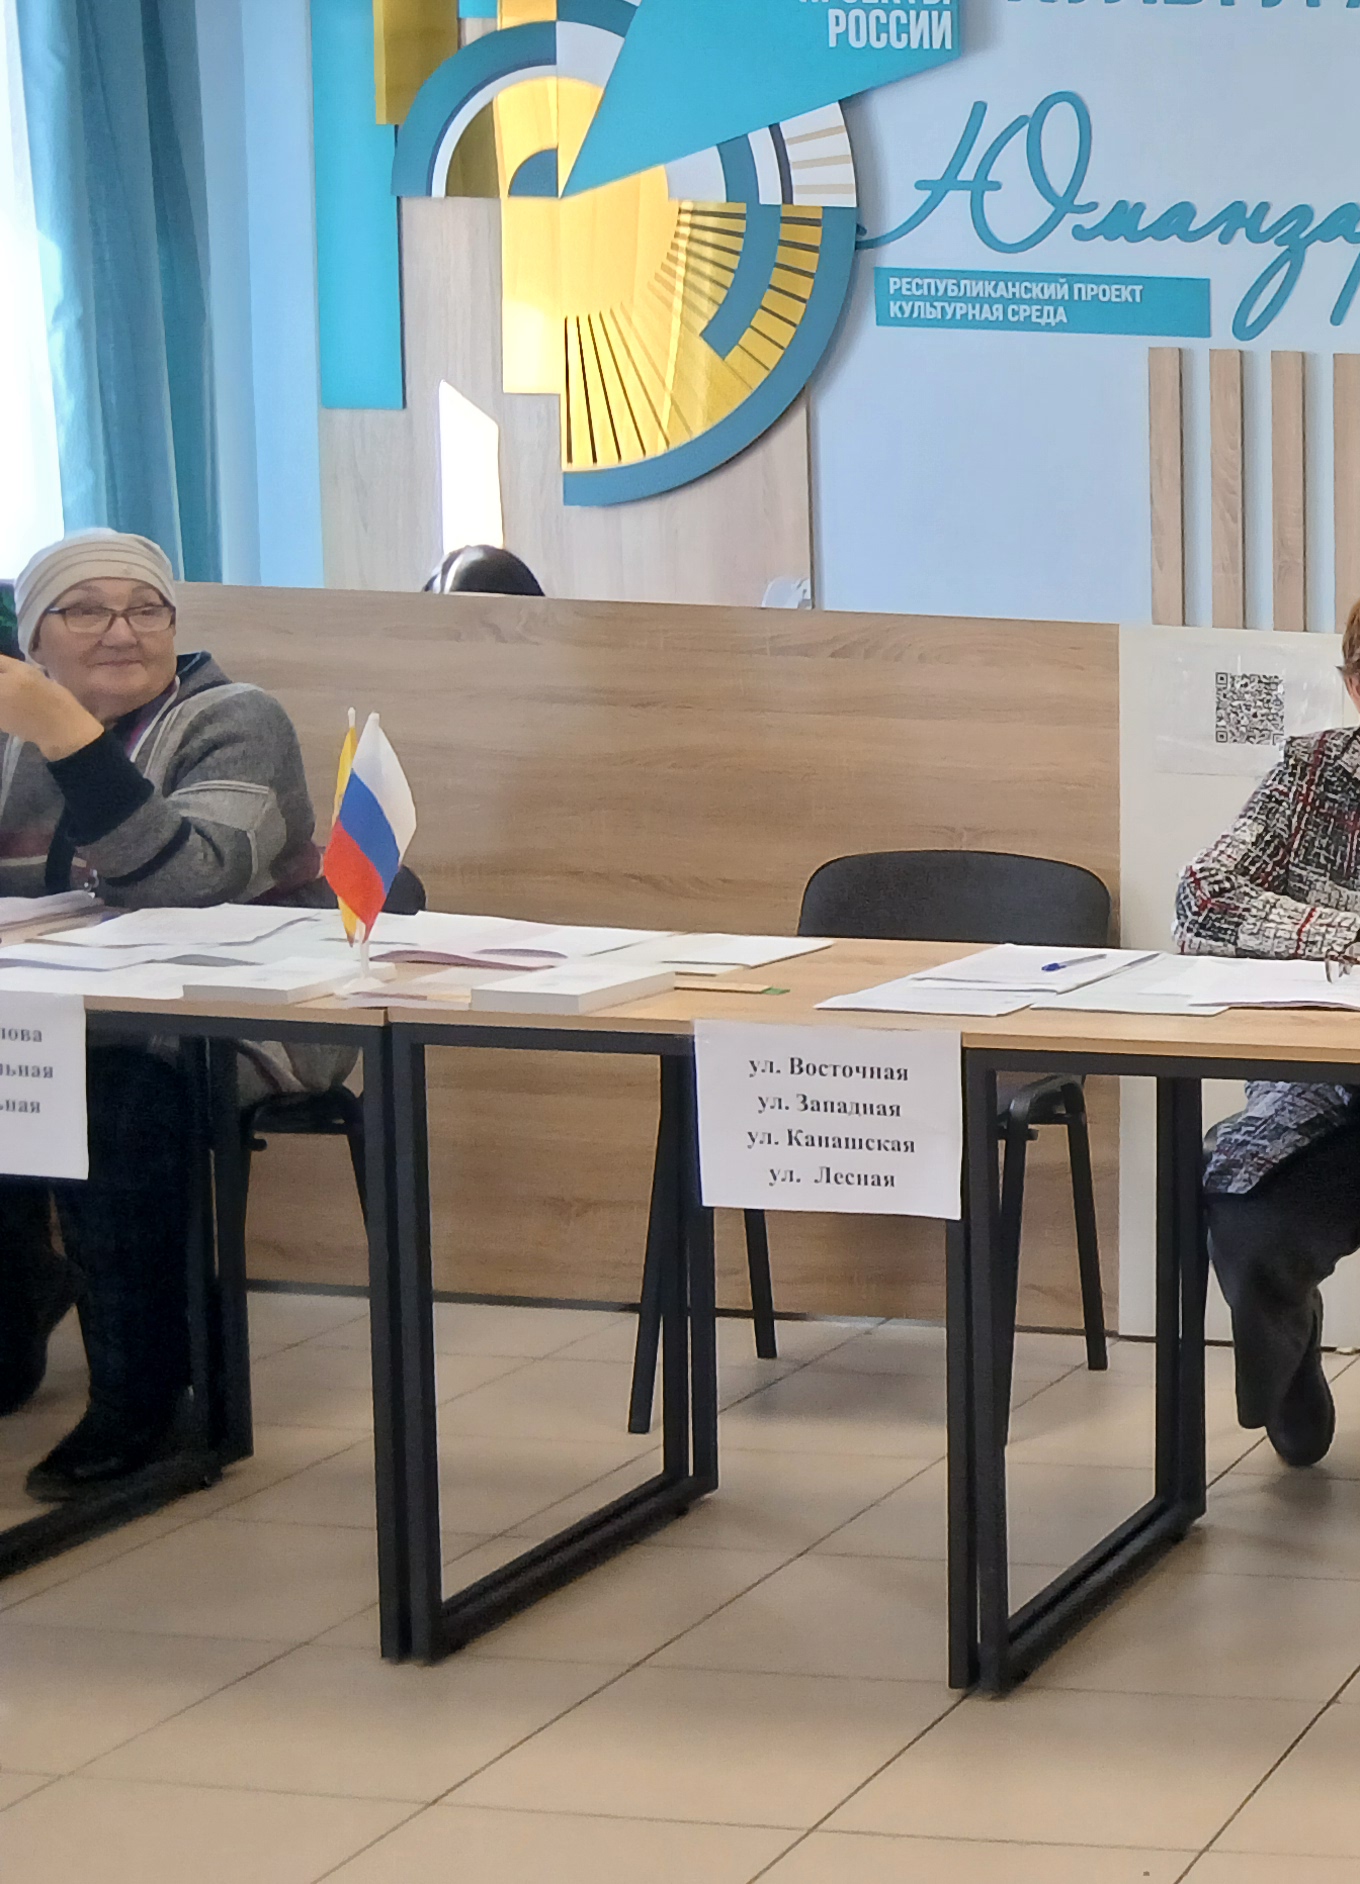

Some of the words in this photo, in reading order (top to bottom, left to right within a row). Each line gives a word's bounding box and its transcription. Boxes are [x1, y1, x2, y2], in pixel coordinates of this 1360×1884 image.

[828, 9, 952, 49] РОССИИ
[889, 277, 1069, 300] РЕСПУБЛИКАНСКИЙ
[1073, 283, 1143, 302] ПРОЕКТ
[889, 301, 1001, 321] КУЛЬТУРНАЯ
[1007, 304, 1067, 326] СРЕДА
[748, 1059, 781, 1078] ул.
[789, 1056, 909, 1081] Восточная
[758, 1095, 790, 1114] ул.
[796, 1093, 902, 1117] Западная
[747, 1130, 779, 1149] ул.
[787, 1128, 915, 1153] Канашская
[768, 1167, 801, 1186] ул.
[814, 1166, 896, 1188] Лесная
